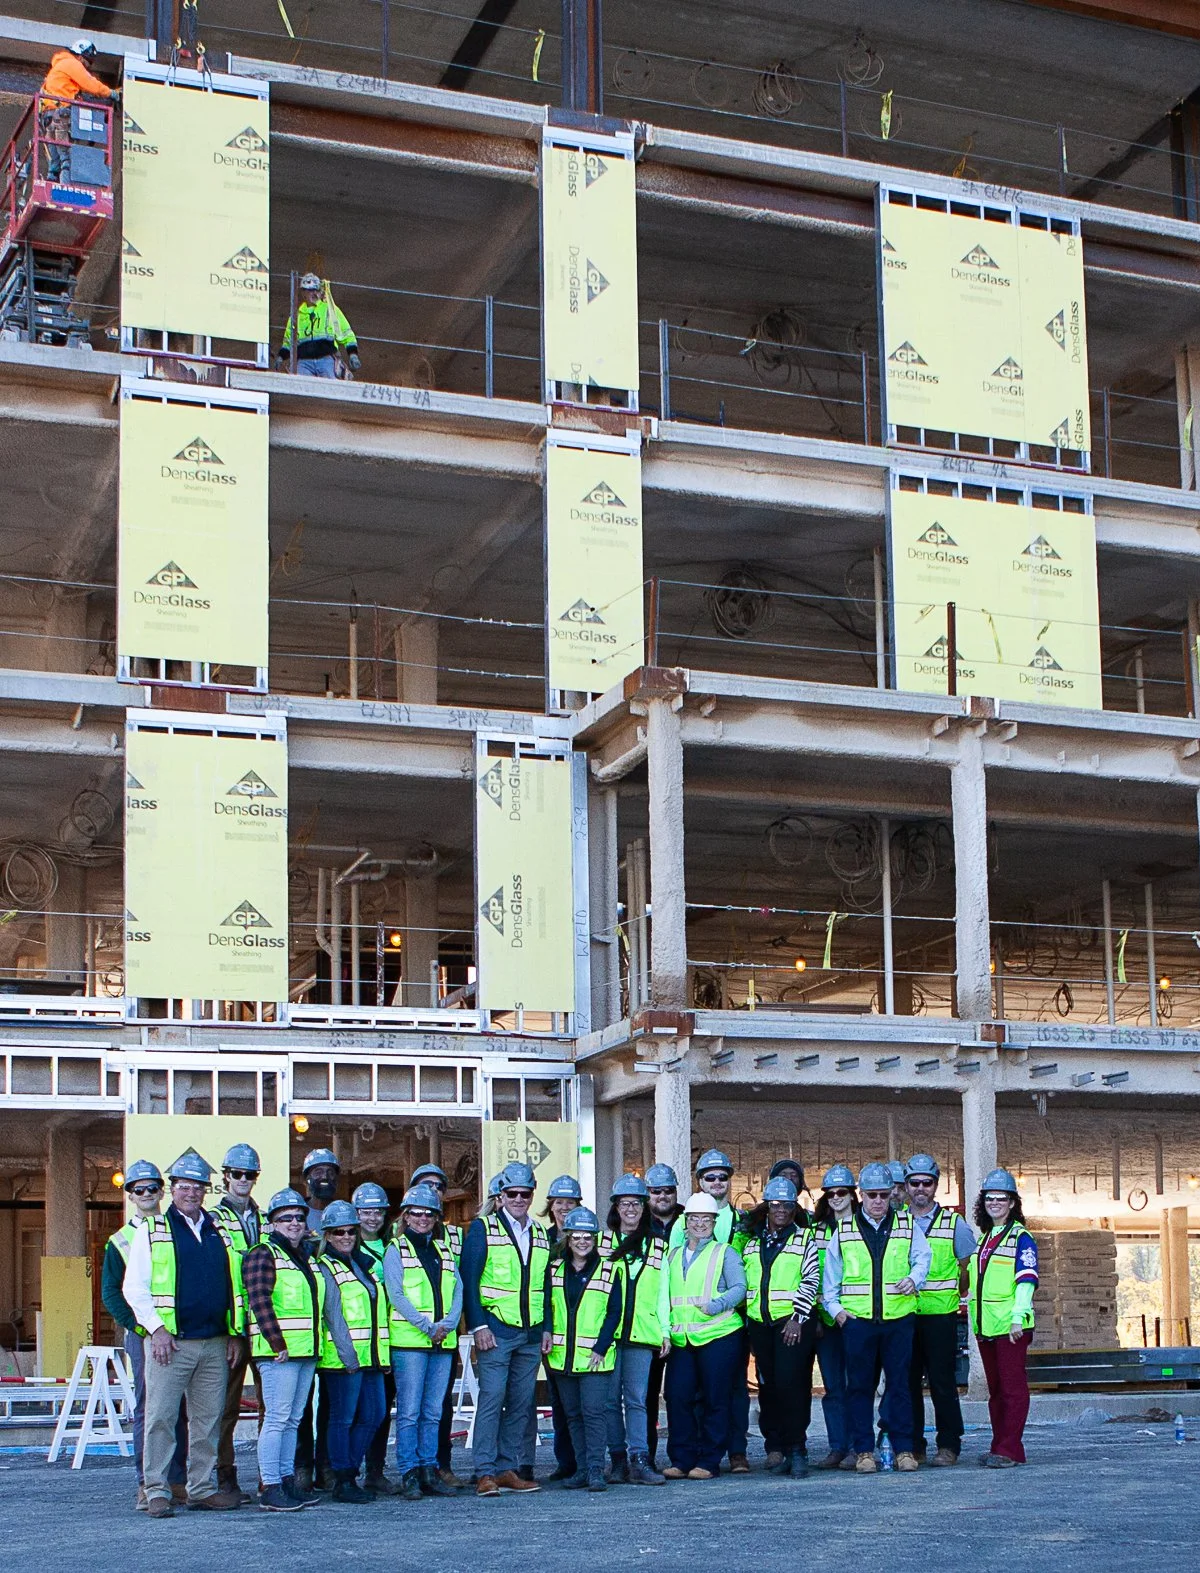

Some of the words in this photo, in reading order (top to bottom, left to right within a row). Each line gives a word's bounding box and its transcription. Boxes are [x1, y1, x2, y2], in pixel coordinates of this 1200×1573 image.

[122, 138, 159, 155] Glass
[213, 152, 269, 171] DensGla
[210, 273, 268, 291] DensGla
[569, 246, 581, 314] DensGlass
[951, 268, 1011, 287] DensGlass
[1069, 301, 1081, 364] DensGlass
[888, 368, 939, 385] ensGlass
[161, 465, 237, 485] DensGlass
[570, 508, 639, 527] DensGlass
[907, 547, 969, 565] DensGlass
[1012, 560, 1073, 578] DensGlass
[133, 591, 211, 610] DensGlass
[509, 758, 521, 821] DensGlas
[511, 874, 523, 948] DensGlass
[208, 932, 285, 948] DensGlass
